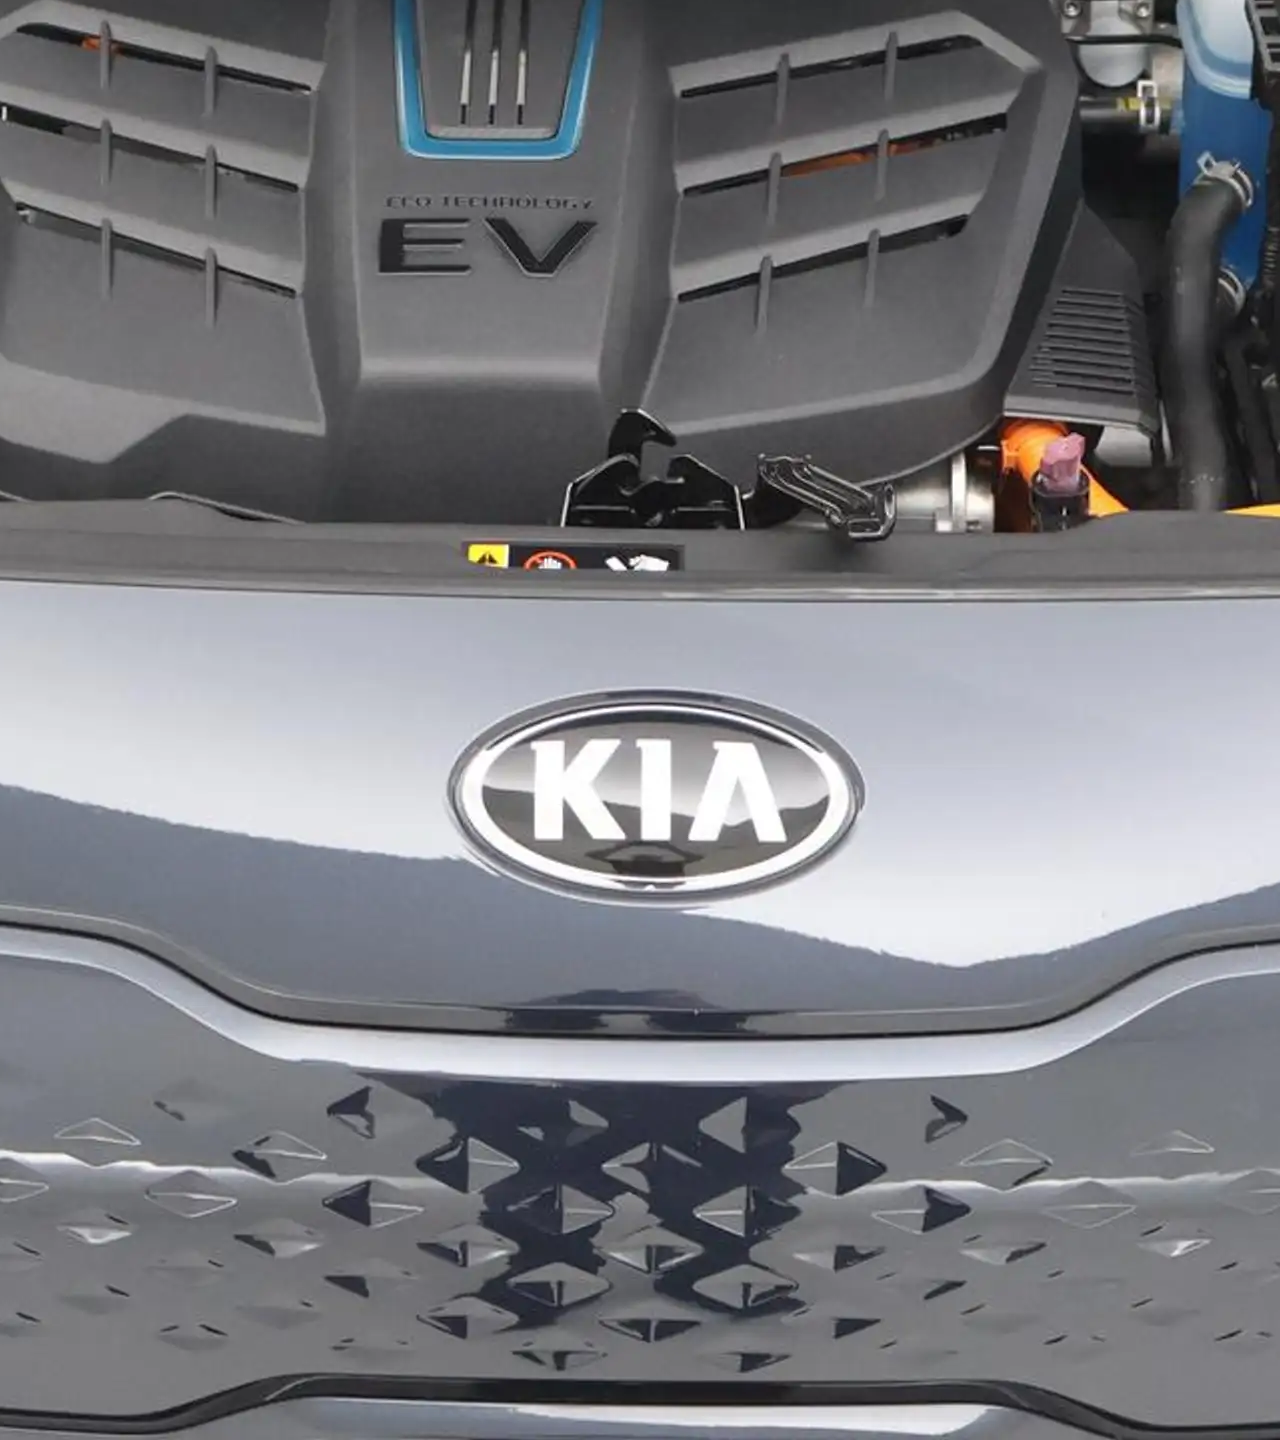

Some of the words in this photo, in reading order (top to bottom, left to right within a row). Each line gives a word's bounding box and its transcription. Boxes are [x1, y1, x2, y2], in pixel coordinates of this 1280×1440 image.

[385, 196, 432, 209] ECO
[440, 195, 594, 210] TECHNOLOGY
[377, 217, 599, 276] EV
[529, 738, 788, 843] KIA
